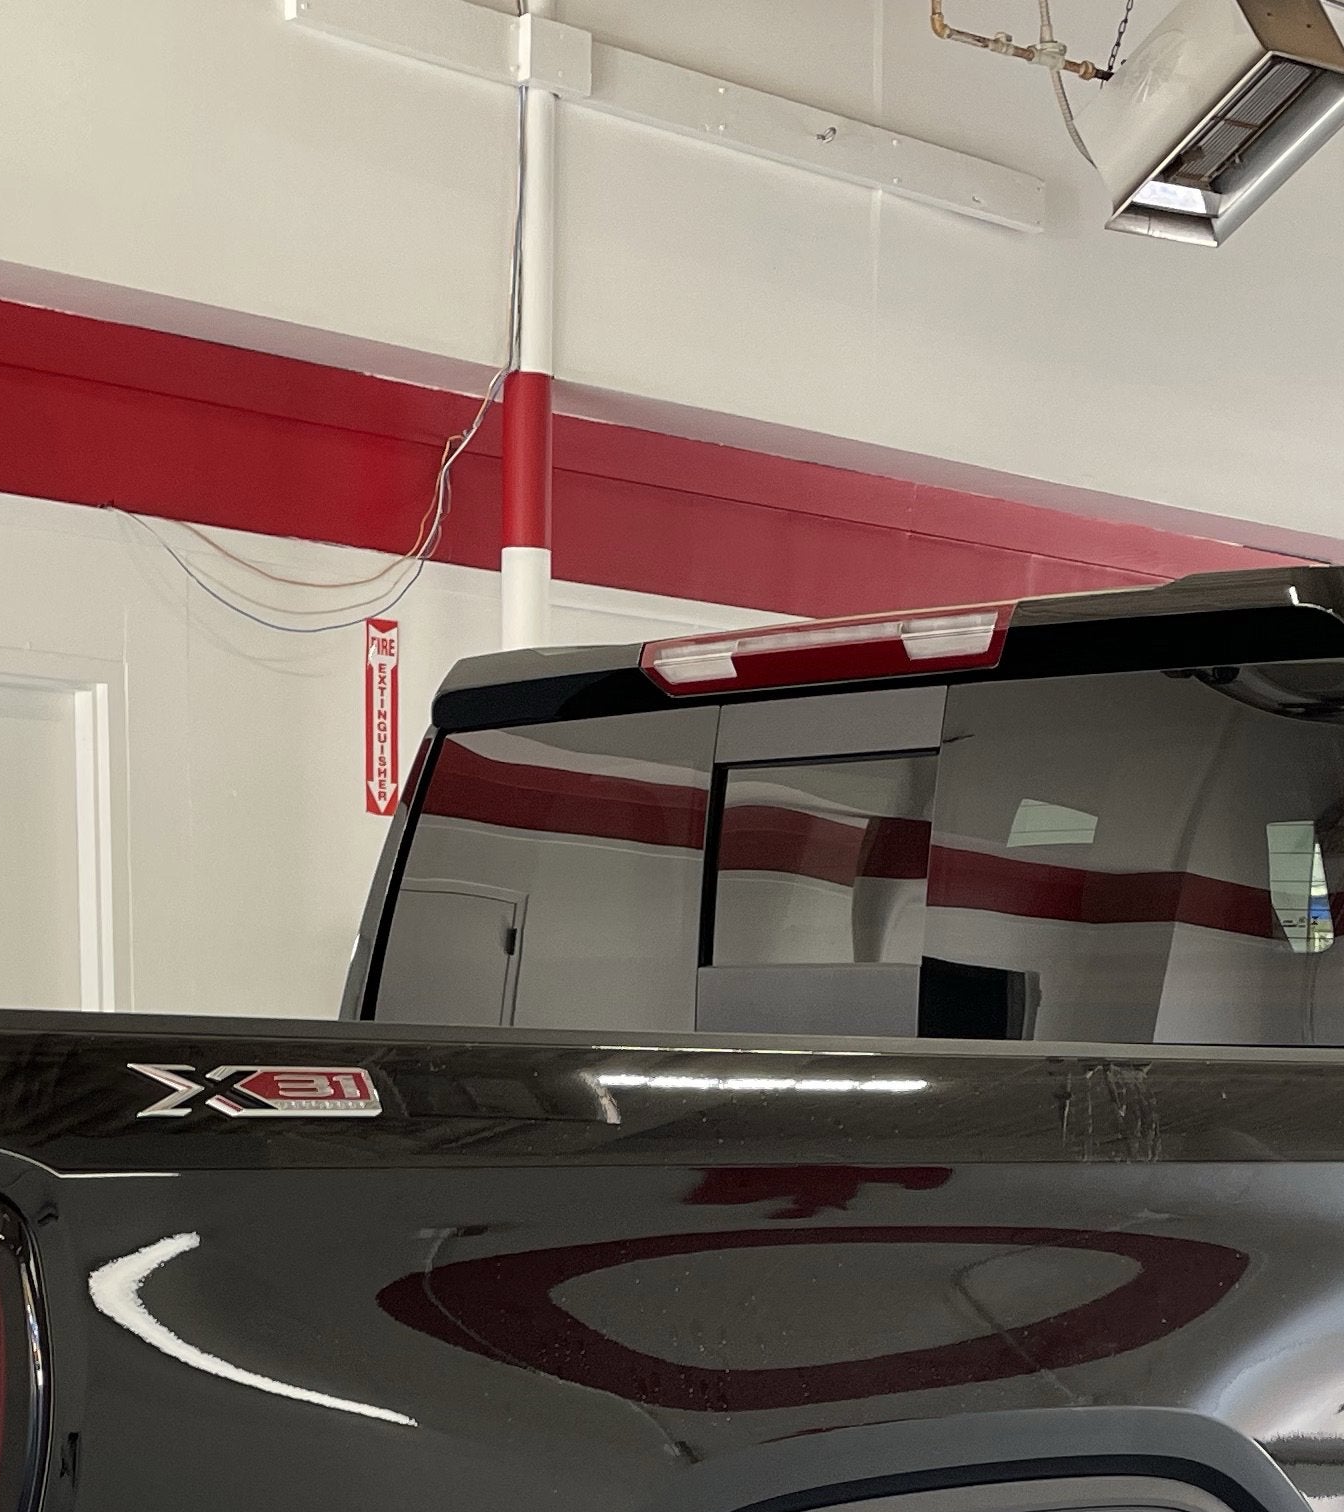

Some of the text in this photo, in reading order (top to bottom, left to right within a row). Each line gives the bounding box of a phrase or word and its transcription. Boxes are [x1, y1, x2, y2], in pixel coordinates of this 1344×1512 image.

[370, 636, 396, 657] FIRE
[376, 662, 388, 801] EXTINGUISHER
[127, 1063, 383, 1118] X31
